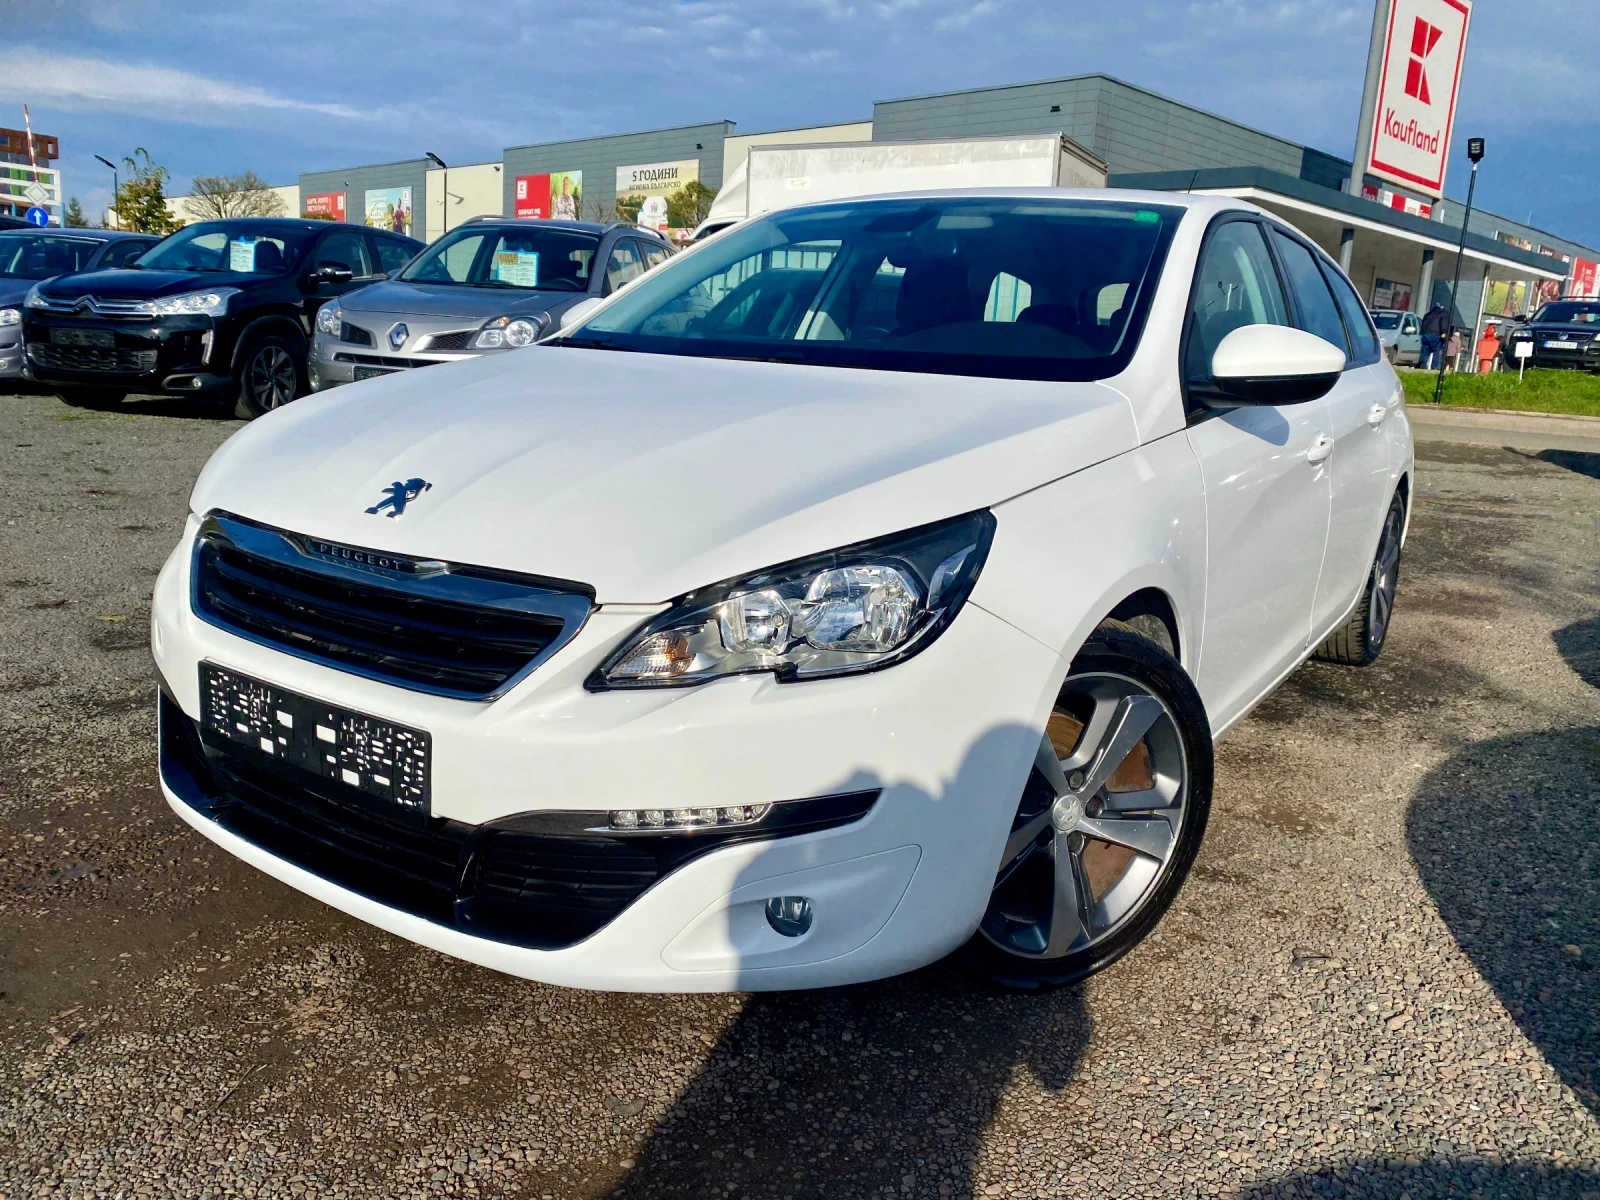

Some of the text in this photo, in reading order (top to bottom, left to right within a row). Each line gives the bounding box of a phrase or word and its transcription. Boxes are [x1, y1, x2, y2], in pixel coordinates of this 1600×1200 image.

[1384, 107, 1440, 154] Kaufland
[632, 167, 679, 182] 5 ГОДИНИ
[320, 543, 401, 570] PEUGEOT
